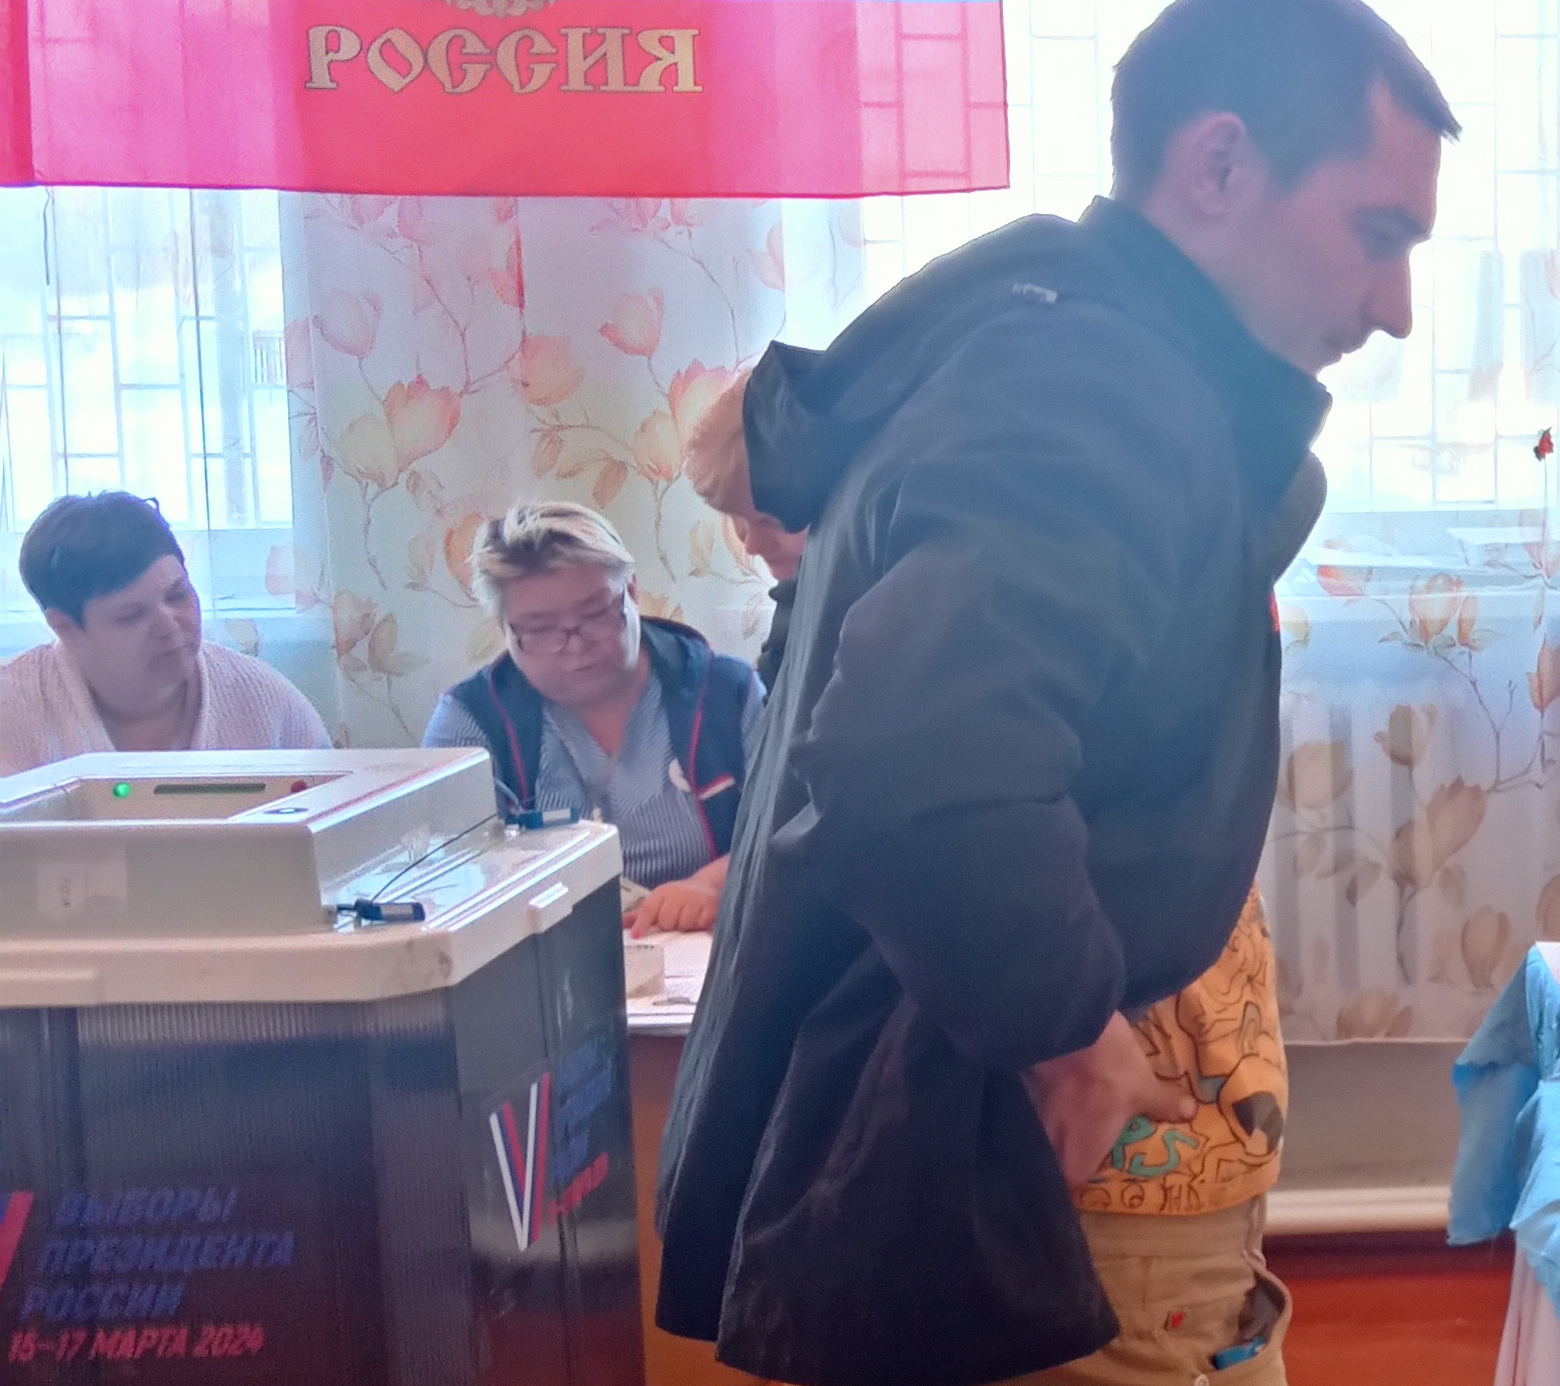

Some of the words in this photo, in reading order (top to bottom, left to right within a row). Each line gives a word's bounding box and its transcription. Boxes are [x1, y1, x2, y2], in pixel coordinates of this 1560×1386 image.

[305, 24, 704, 95] РОССИЯ
[38, 1231, 295, 1273] ПРЕЗИДЕНТА
[90, 1325, 189, 1361] МАРТА
[193, 1321, 265, 1359] 2024
